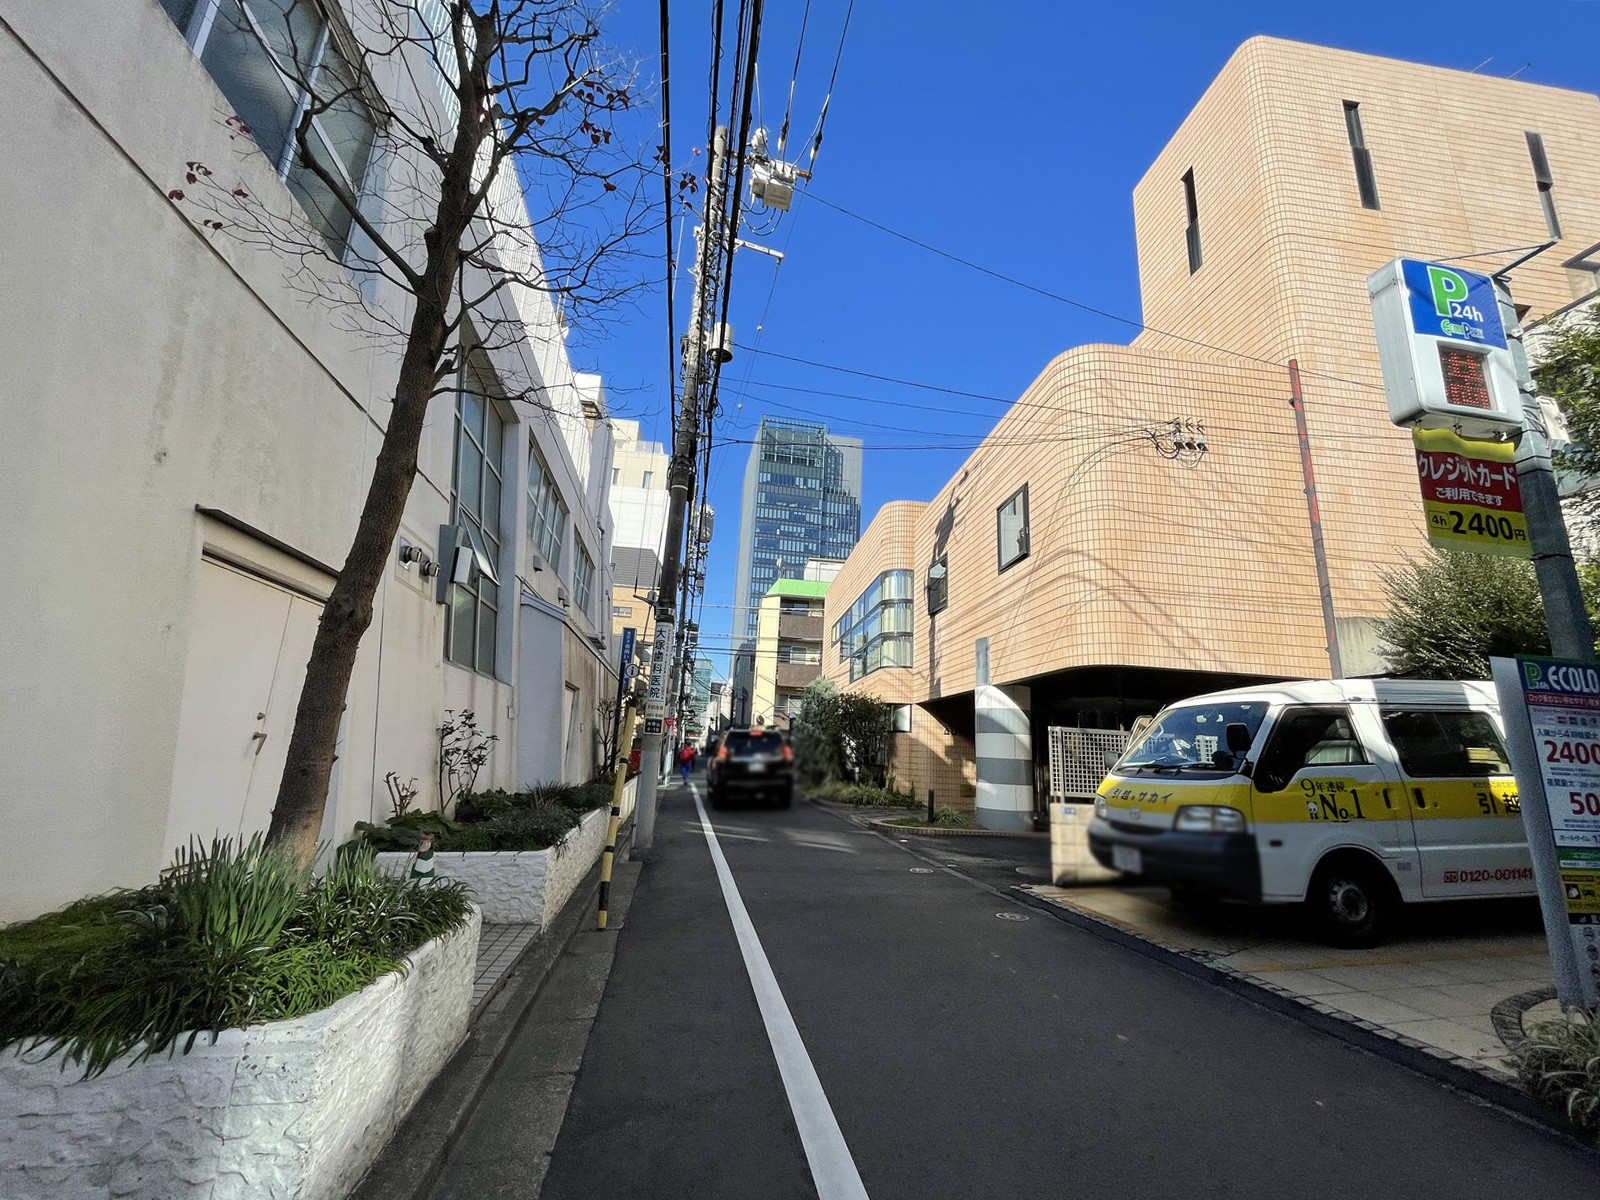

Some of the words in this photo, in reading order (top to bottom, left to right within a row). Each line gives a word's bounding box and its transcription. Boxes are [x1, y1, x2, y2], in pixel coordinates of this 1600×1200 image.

[1426, 265, 1468, 318] P
[1451, 303, 1484, 322] 24h
[1418, 454, 1516, 491] クレジットカード
[1435, 487, 1503, 506] ご利用できます
[1431, 515, 1448, 526] 4h
[649, 628, 667, 699] 大塚歯科医院
[1523, 661, 1543, 689] P
[1547, 665, 1600, 693] ECOLO
